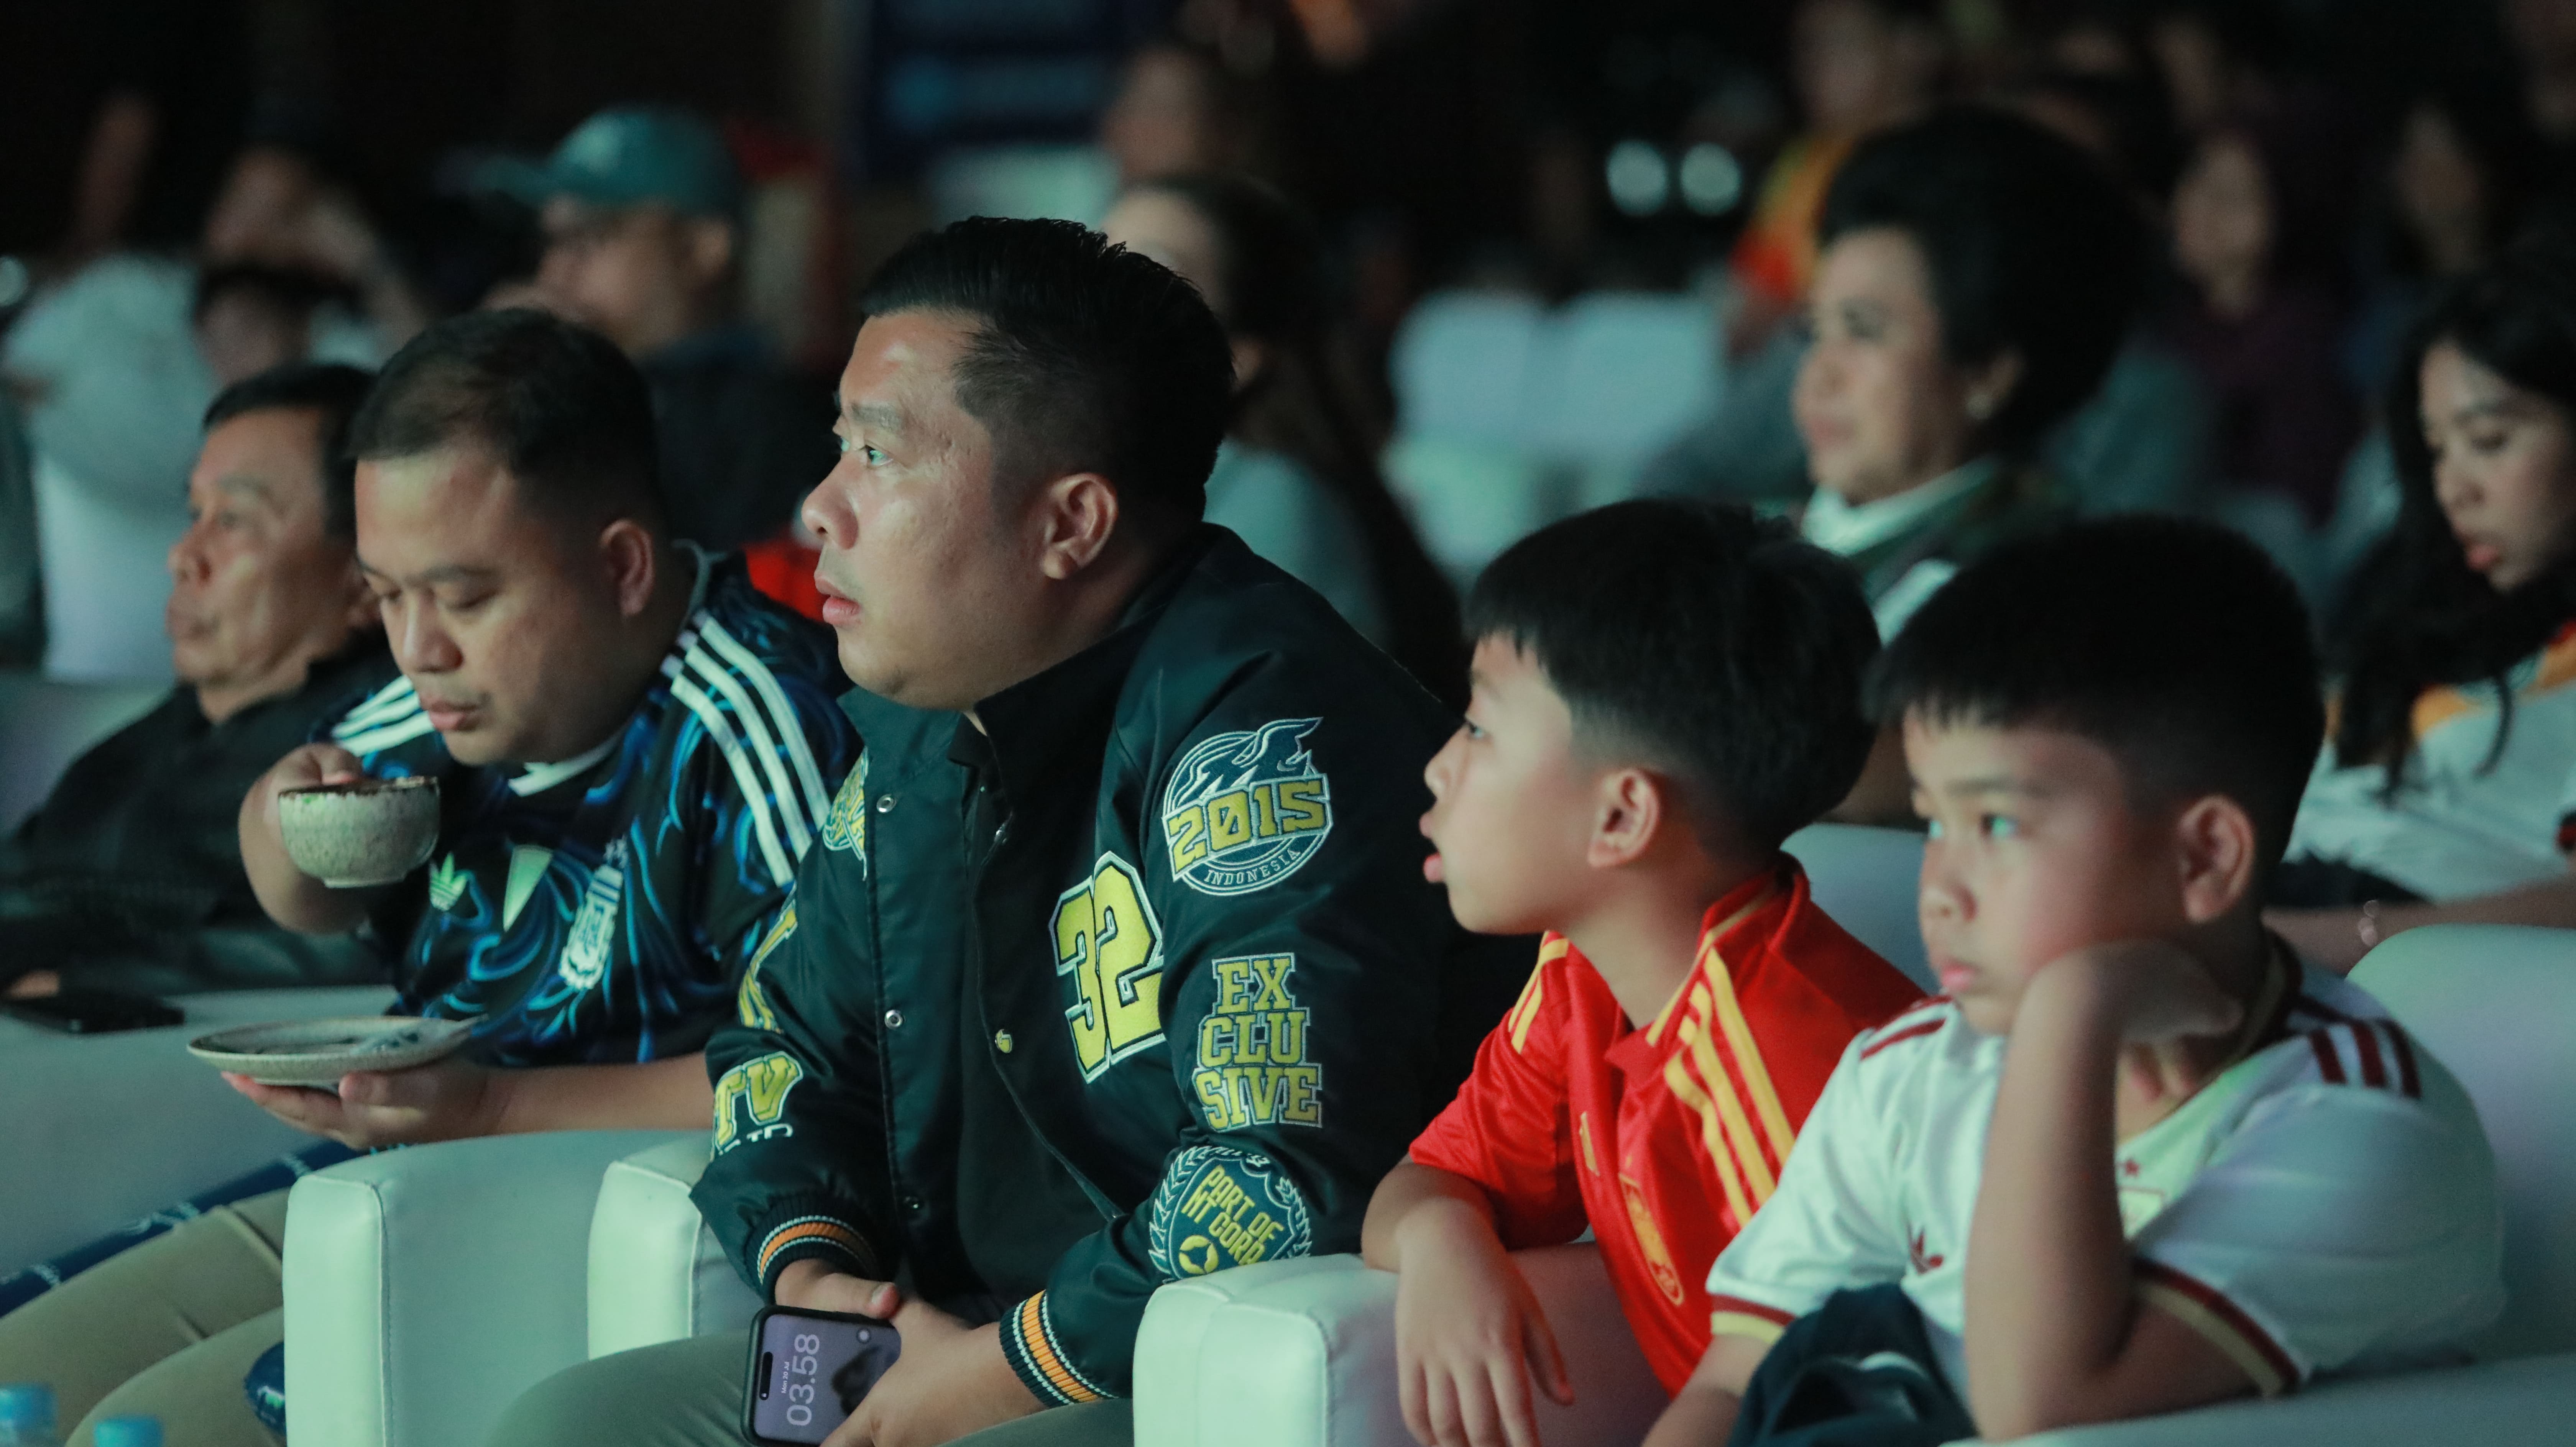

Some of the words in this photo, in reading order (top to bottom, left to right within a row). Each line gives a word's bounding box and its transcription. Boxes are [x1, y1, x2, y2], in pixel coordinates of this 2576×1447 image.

[1167, 779, 1327, 874] 2015
[1203, 848, 1301, 885] INDONESIA
[1053, 860, 1165, 1076] 32
[1217, 957, 1292, 1015] EX
[1200, 1011, 1306, 1068] CLU
[1195, 1065, 1319, 1130] SIVE
[1201, 1164, 1255, 1222] PART
[1248, 1212, 1284, 1243] OF
[782, 1372, 789, 1380] 20
[786, 1334, 820, 1426] 03.58
